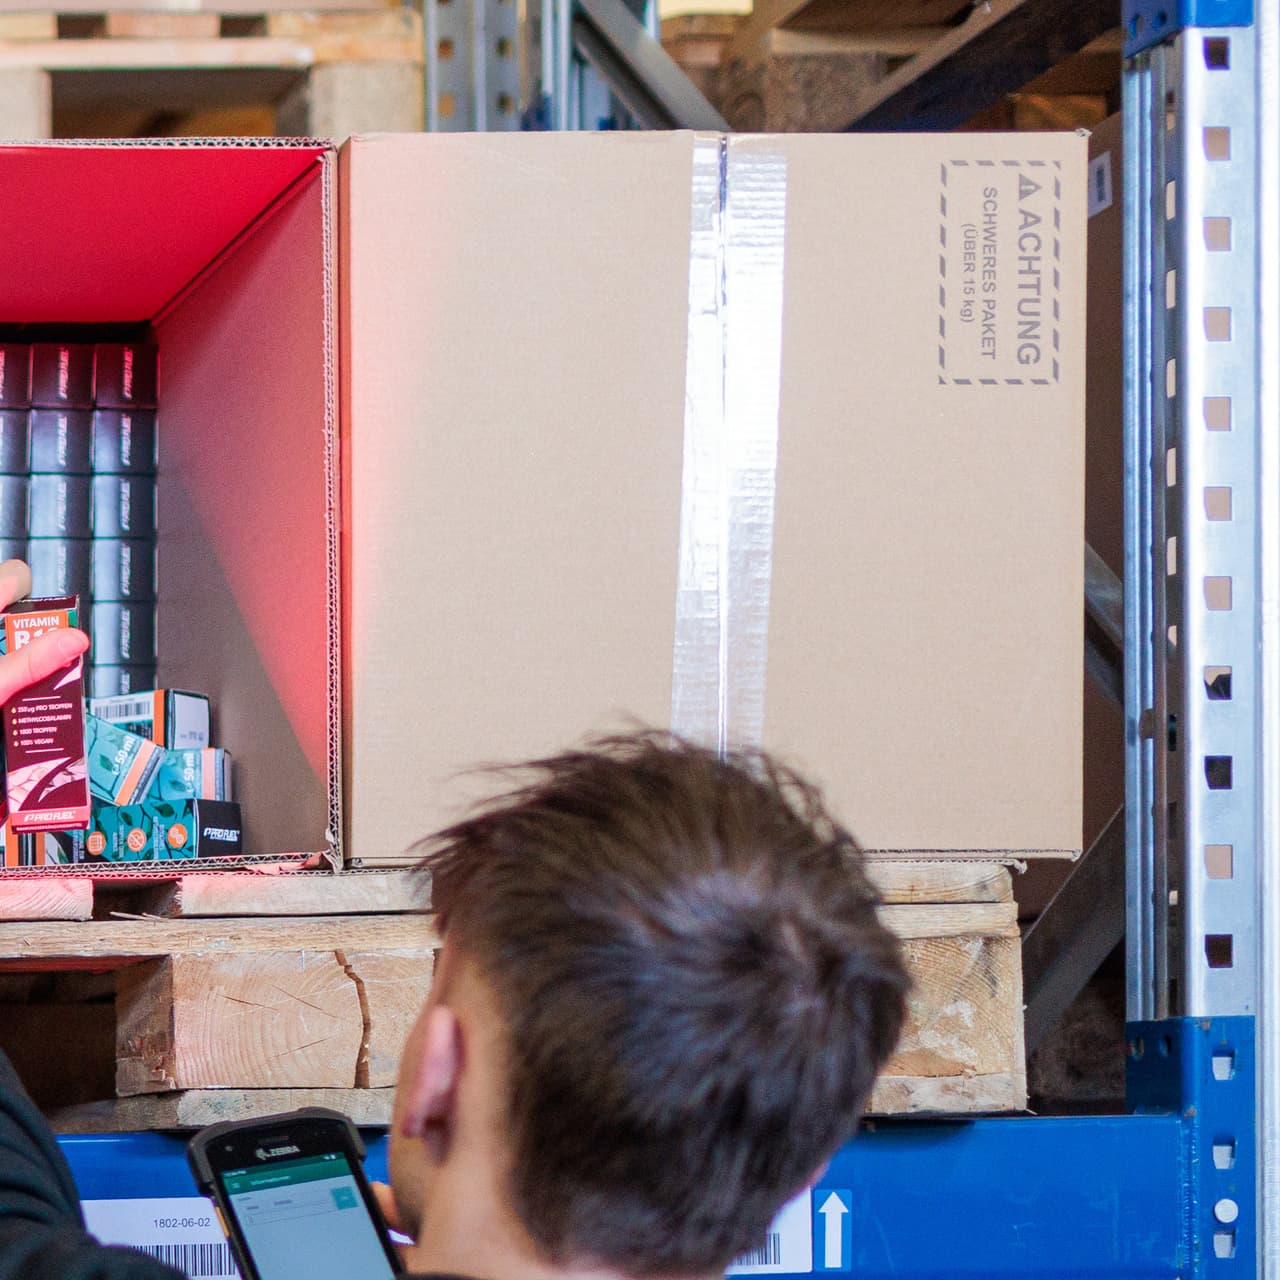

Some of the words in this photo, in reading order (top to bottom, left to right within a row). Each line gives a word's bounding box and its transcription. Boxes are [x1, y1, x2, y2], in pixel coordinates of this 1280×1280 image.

[961, 223, 976, 273] (ÜBER
[981, 187, 998, 293] SCHWERES
[962, 280, 975, 296] 15
[1017, 208, 1041, 365] ACHTUNG
[959, 299, 975, 324] kg)
[980, 299, 997, 360] PAKET
[13, 616, 60, 628] VITAMIN
[33, 726, 58, 734] TROPFEN
[118, 748, 129, 764] 50
[184, 766, 194, 783] 50
[154, 1217, 211, 1228] 1802-06-02
